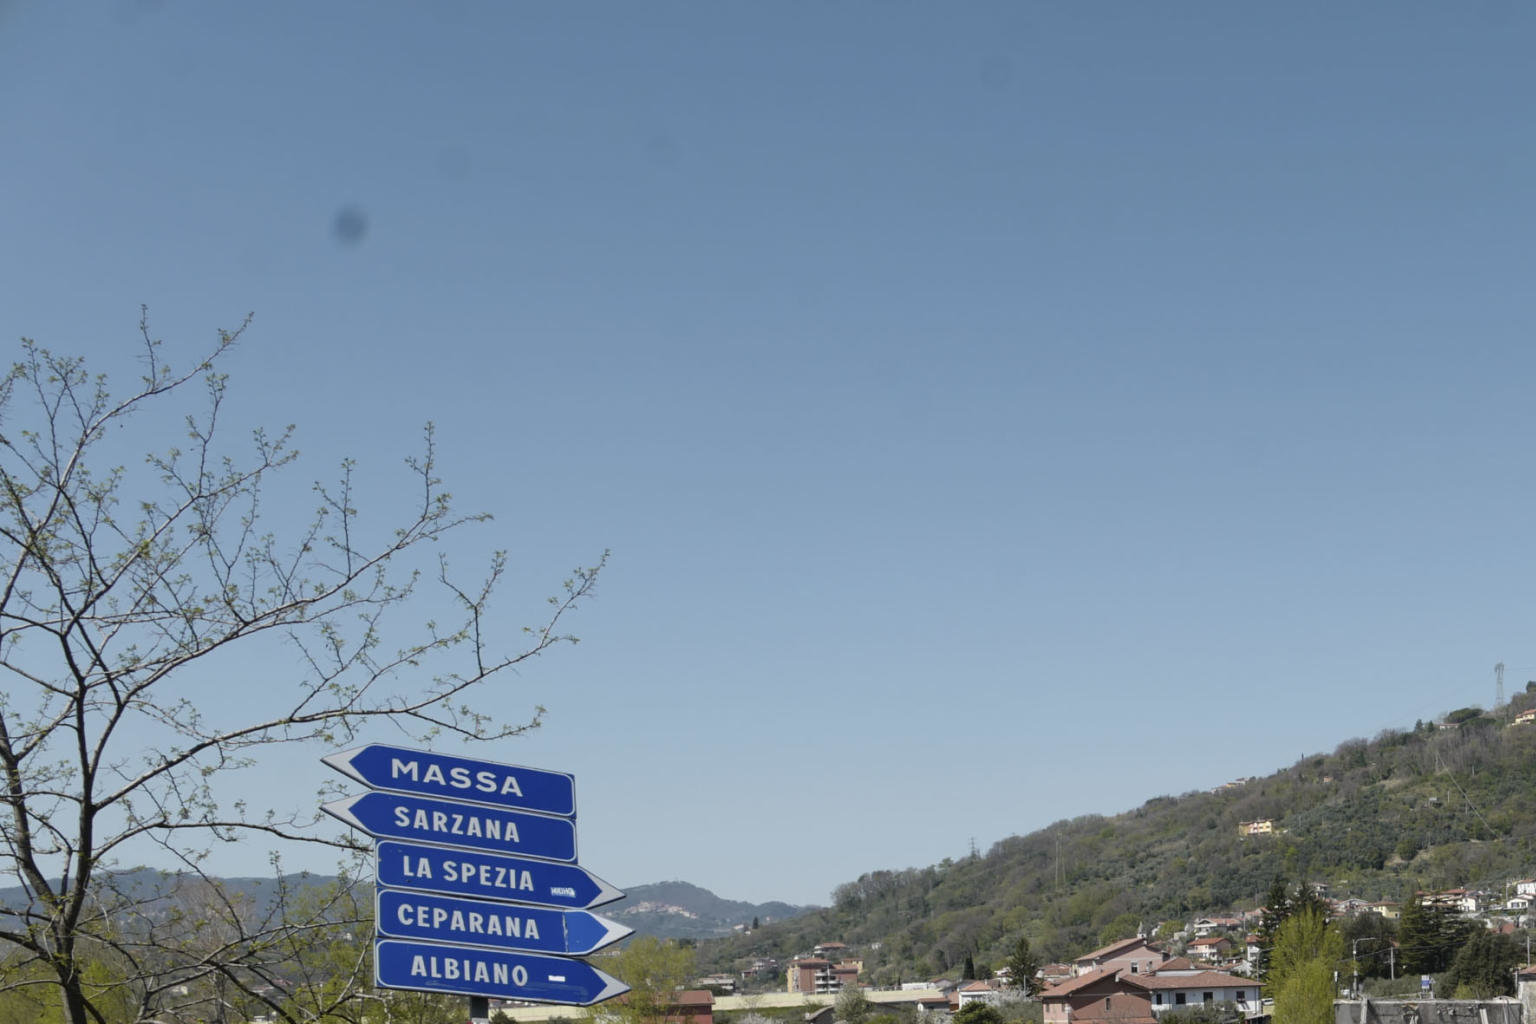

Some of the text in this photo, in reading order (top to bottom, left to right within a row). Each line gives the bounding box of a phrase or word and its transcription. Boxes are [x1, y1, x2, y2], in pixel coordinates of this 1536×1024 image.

[391, 758, 523, 797] MASSA
[394, 806, 520, 843] SARZANA
[403, 855, 534, 891] LA SPEZIA
[397, 903, 540, 940] CEPARANA
[411, 954, 528, 987] ALBIANO
